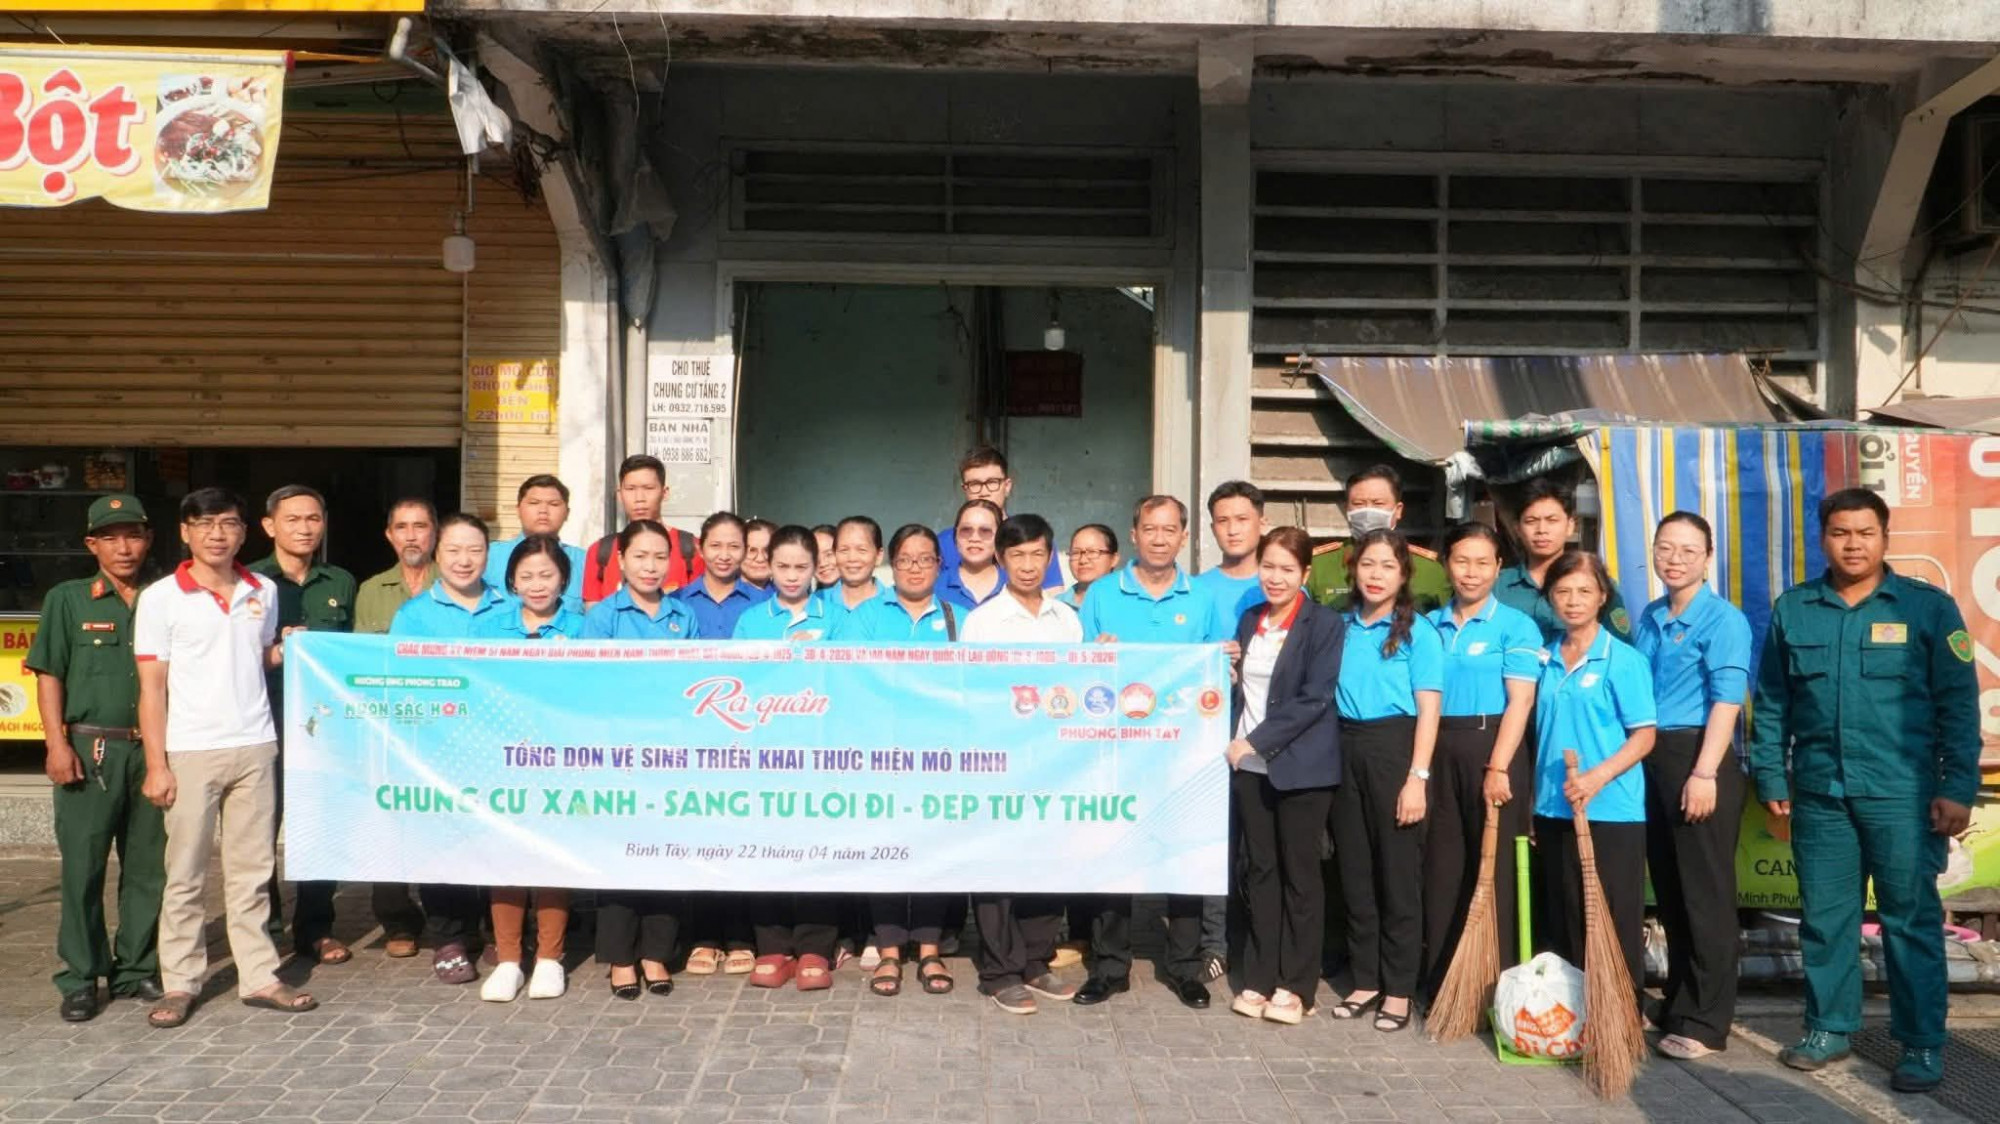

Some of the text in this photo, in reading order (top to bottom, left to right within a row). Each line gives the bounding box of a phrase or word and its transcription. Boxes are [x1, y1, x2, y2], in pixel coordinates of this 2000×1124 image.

[672, 360, 689, 376] CHO
[653, 382, 683, 398] CHUNG
[720, 383, 727, 399] 2
[641, 748, 688, 768] SINH
[758, 749, 804, 770] KHAI
[541, 790, 636, 816] XANH
[737, 844, 757, 858] 22
[808, 846, 828, 859] 04
[870, 847, 909, 860] 2026
